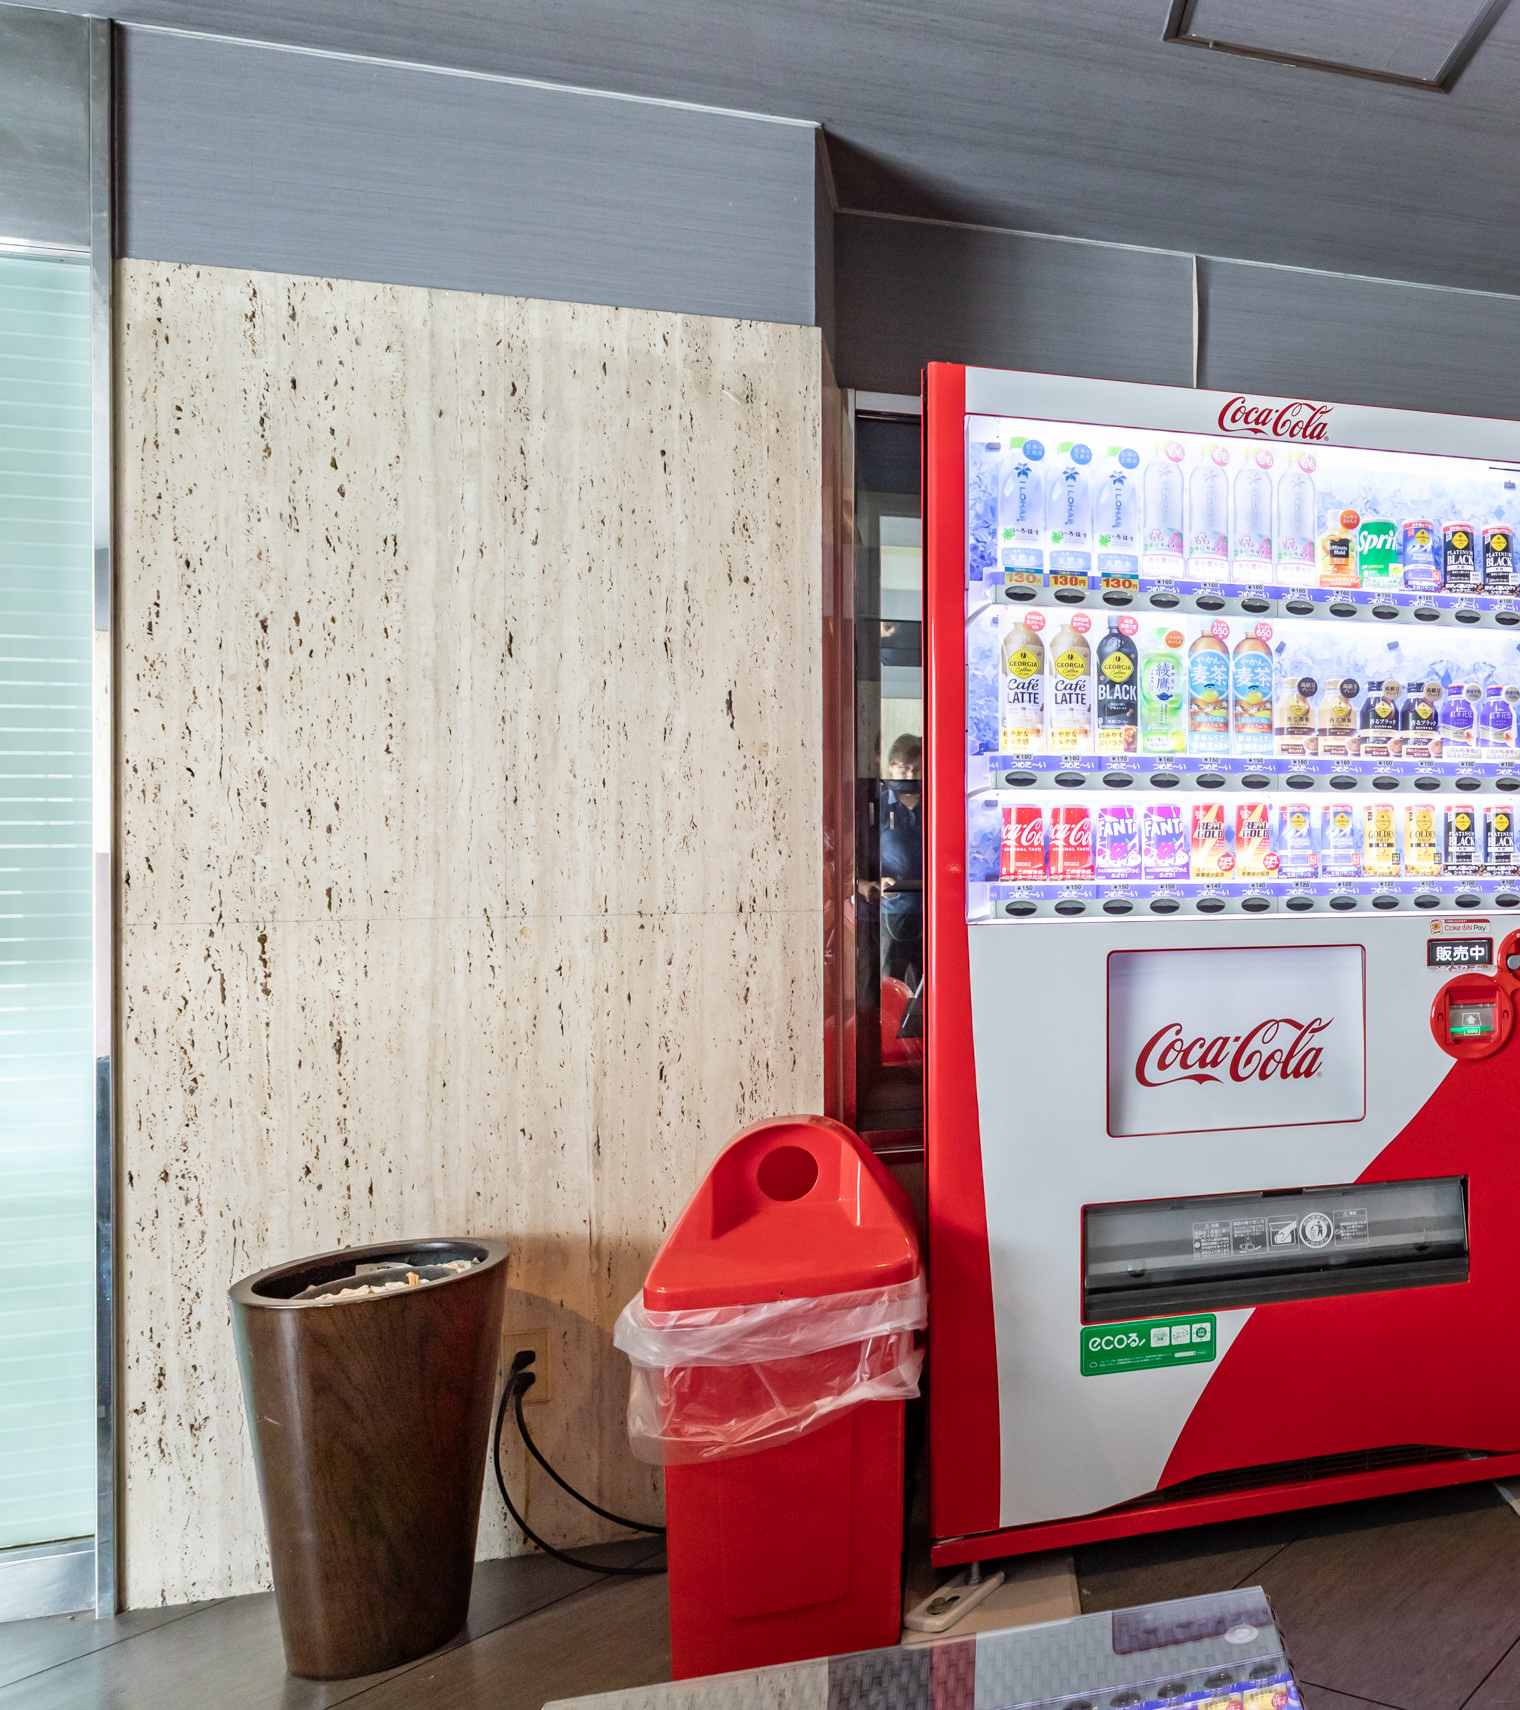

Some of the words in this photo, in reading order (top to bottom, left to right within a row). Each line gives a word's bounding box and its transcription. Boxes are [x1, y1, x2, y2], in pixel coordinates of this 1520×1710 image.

[1218, 396, 1335, 440] Coca-Cola
[1447, 555, 1474, 565] BLACK
[1486, 557, 1512, 567] BLACK
[1052, 576, 1086, 586] 130円
[1103, 578, 1138, 590] 130円
[1213, 627, 1228, 636] 650
[1256, 629, 1272, 637] 650
[1156, 662, 1172, 692] 綾鷹
[1191, 664, 1228, 686] 麦茶
[1235, 667, 1271, 687] 麦茶
[1008, 678, 1039, 691] Café
[1055, 679, 1086, 692] Café
[1008, 692, 1039, 704] LATTE
[1055, 692, 1086, 705] LATTE
[1099, 684, 1136, 701] BLACK
[1198, 819, 1223, 830] REAL
[1243, 819, 1268, 829] REAL
[1197, 829, 1223, 838] GOLD
[1242, 829, 1269, 838] GOLD
[1449, 836, 1475, 846] BLACK
[1488, 837, 1514, 846] BLACK
[1436, 945, 1485, 962] 販売中
[1135, 1016, 1335, 1088] Coca-Cola
